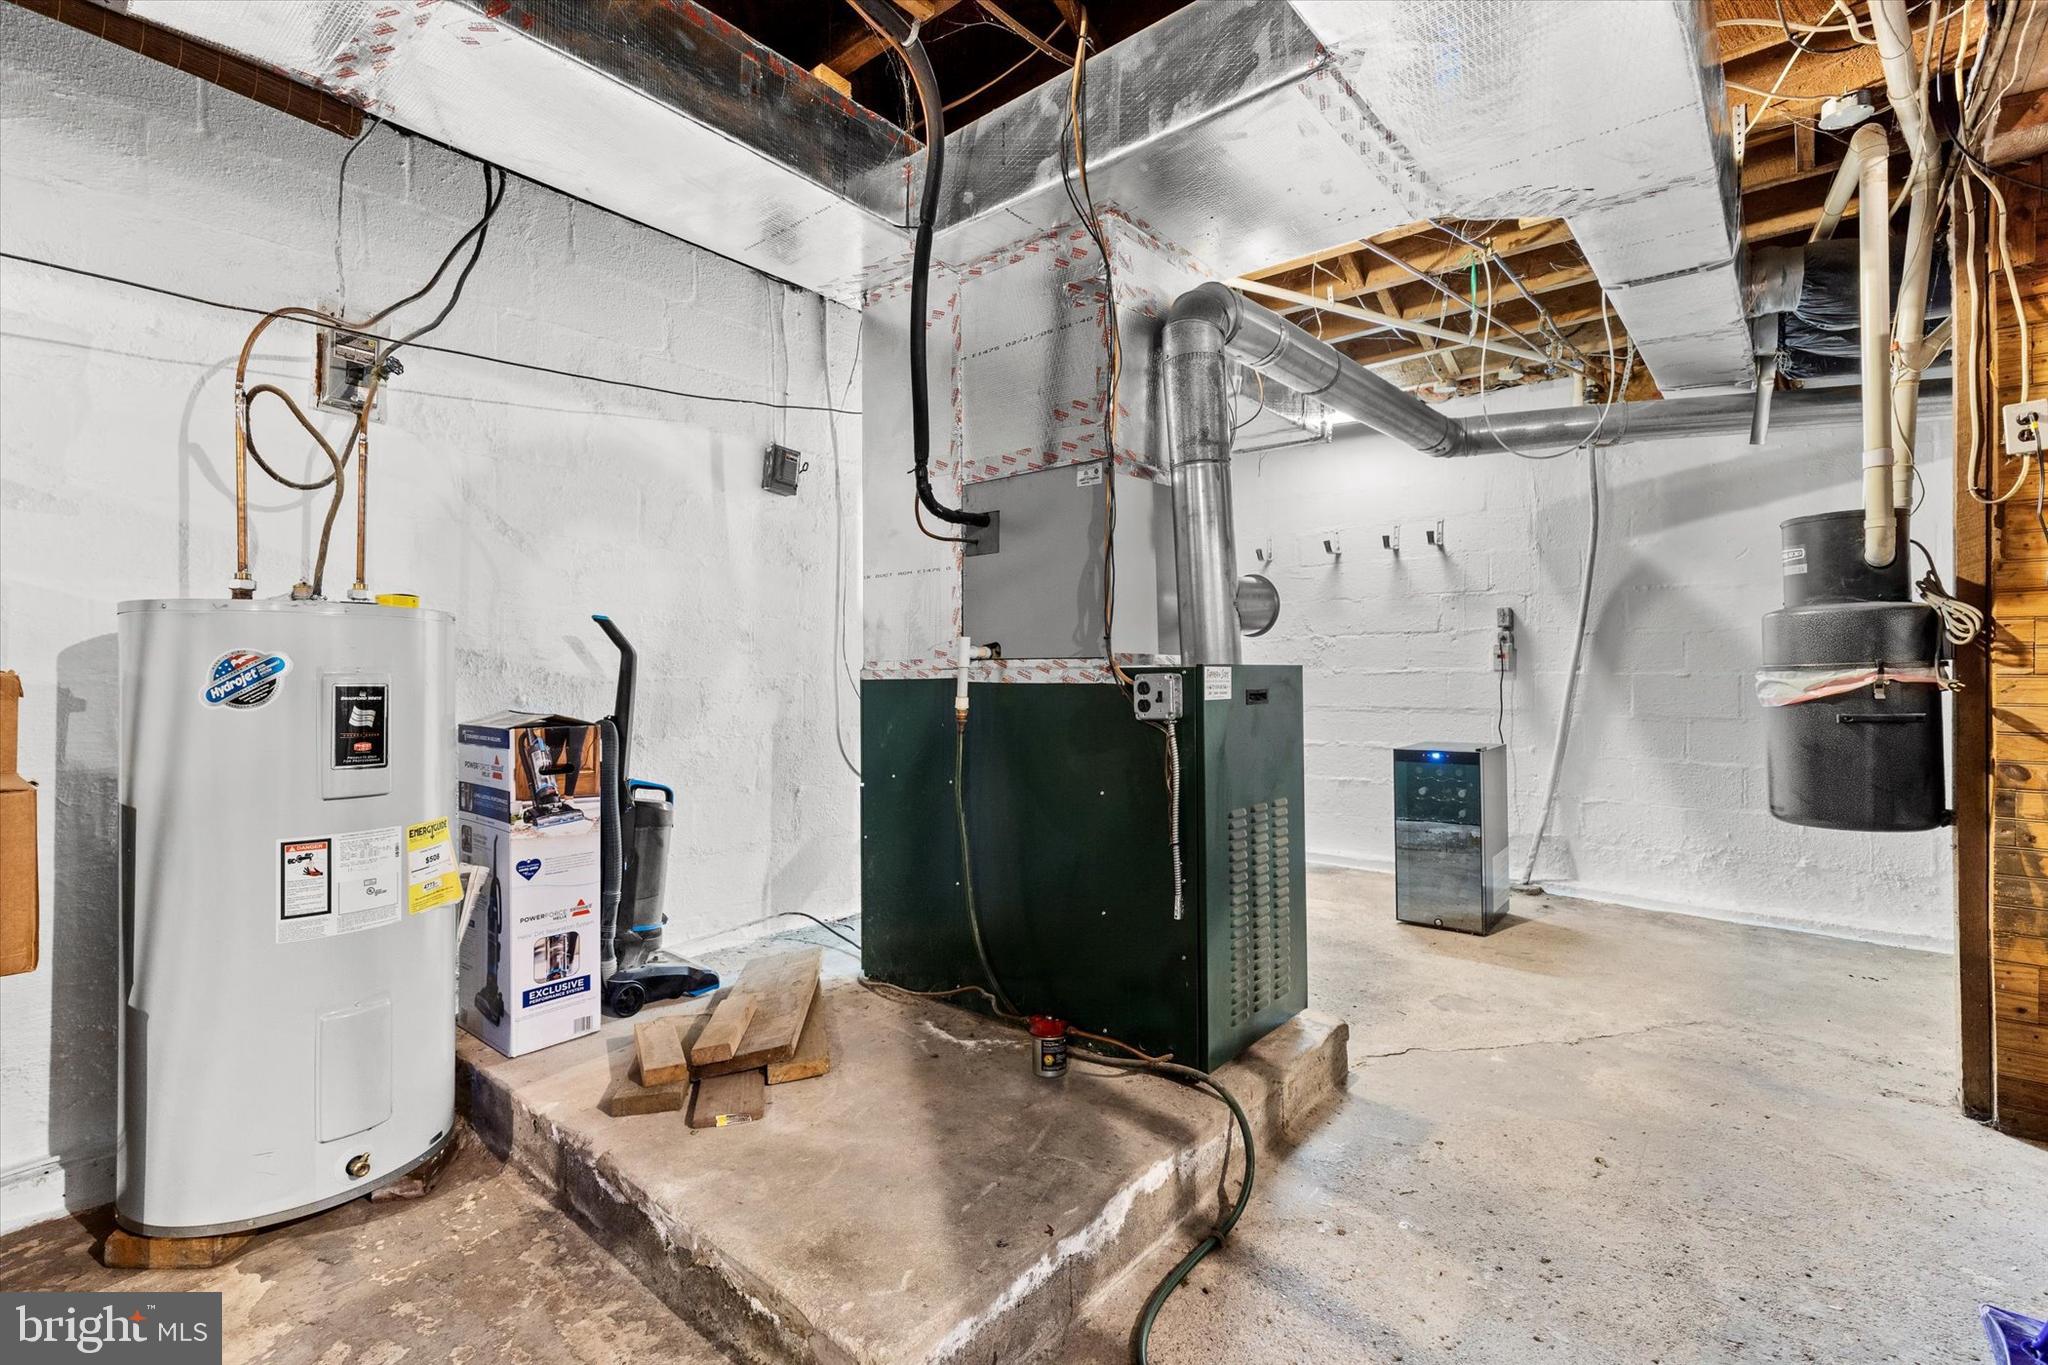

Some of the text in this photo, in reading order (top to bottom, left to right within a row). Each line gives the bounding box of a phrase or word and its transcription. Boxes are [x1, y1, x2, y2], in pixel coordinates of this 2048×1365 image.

[210, 667, 258, 699] Hydrojet
[528, 986, 585, 1005] PERFORMANCE SYSTEM
[529, 978, 585, 1000] EXCLUSIVE
